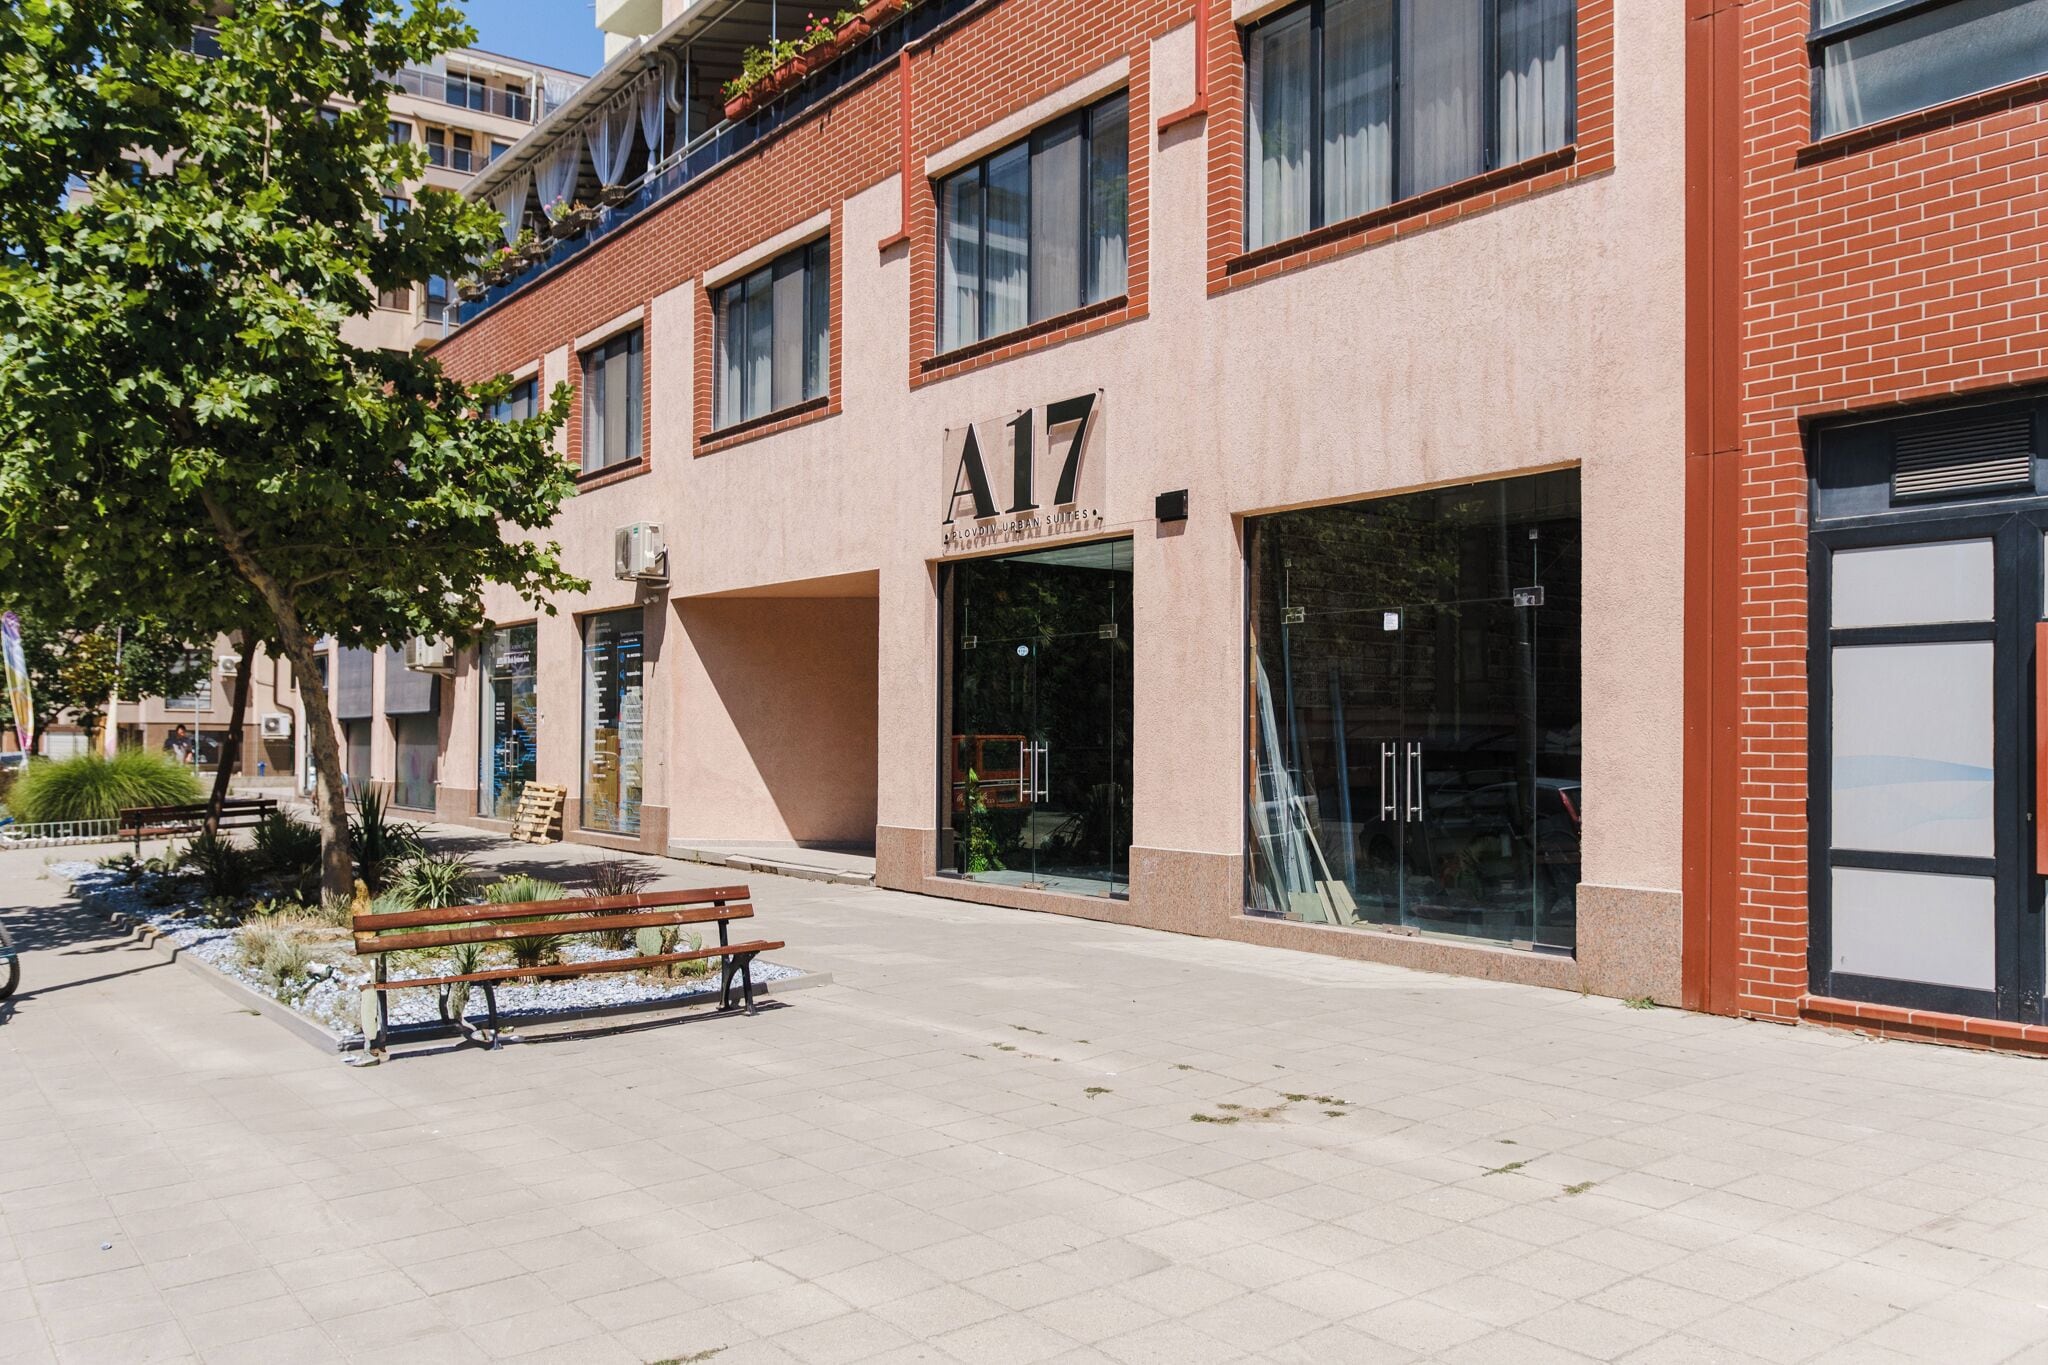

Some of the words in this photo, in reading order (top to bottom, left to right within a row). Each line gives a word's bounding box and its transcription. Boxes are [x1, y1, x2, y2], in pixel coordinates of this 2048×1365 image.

[943, 393, 1096, 524] A17
[952, 524, 997, 540] PLOVDIV
[1002, 516, 1040, 532] URBAN
[1046, 509, 1088, 525] SUITES
